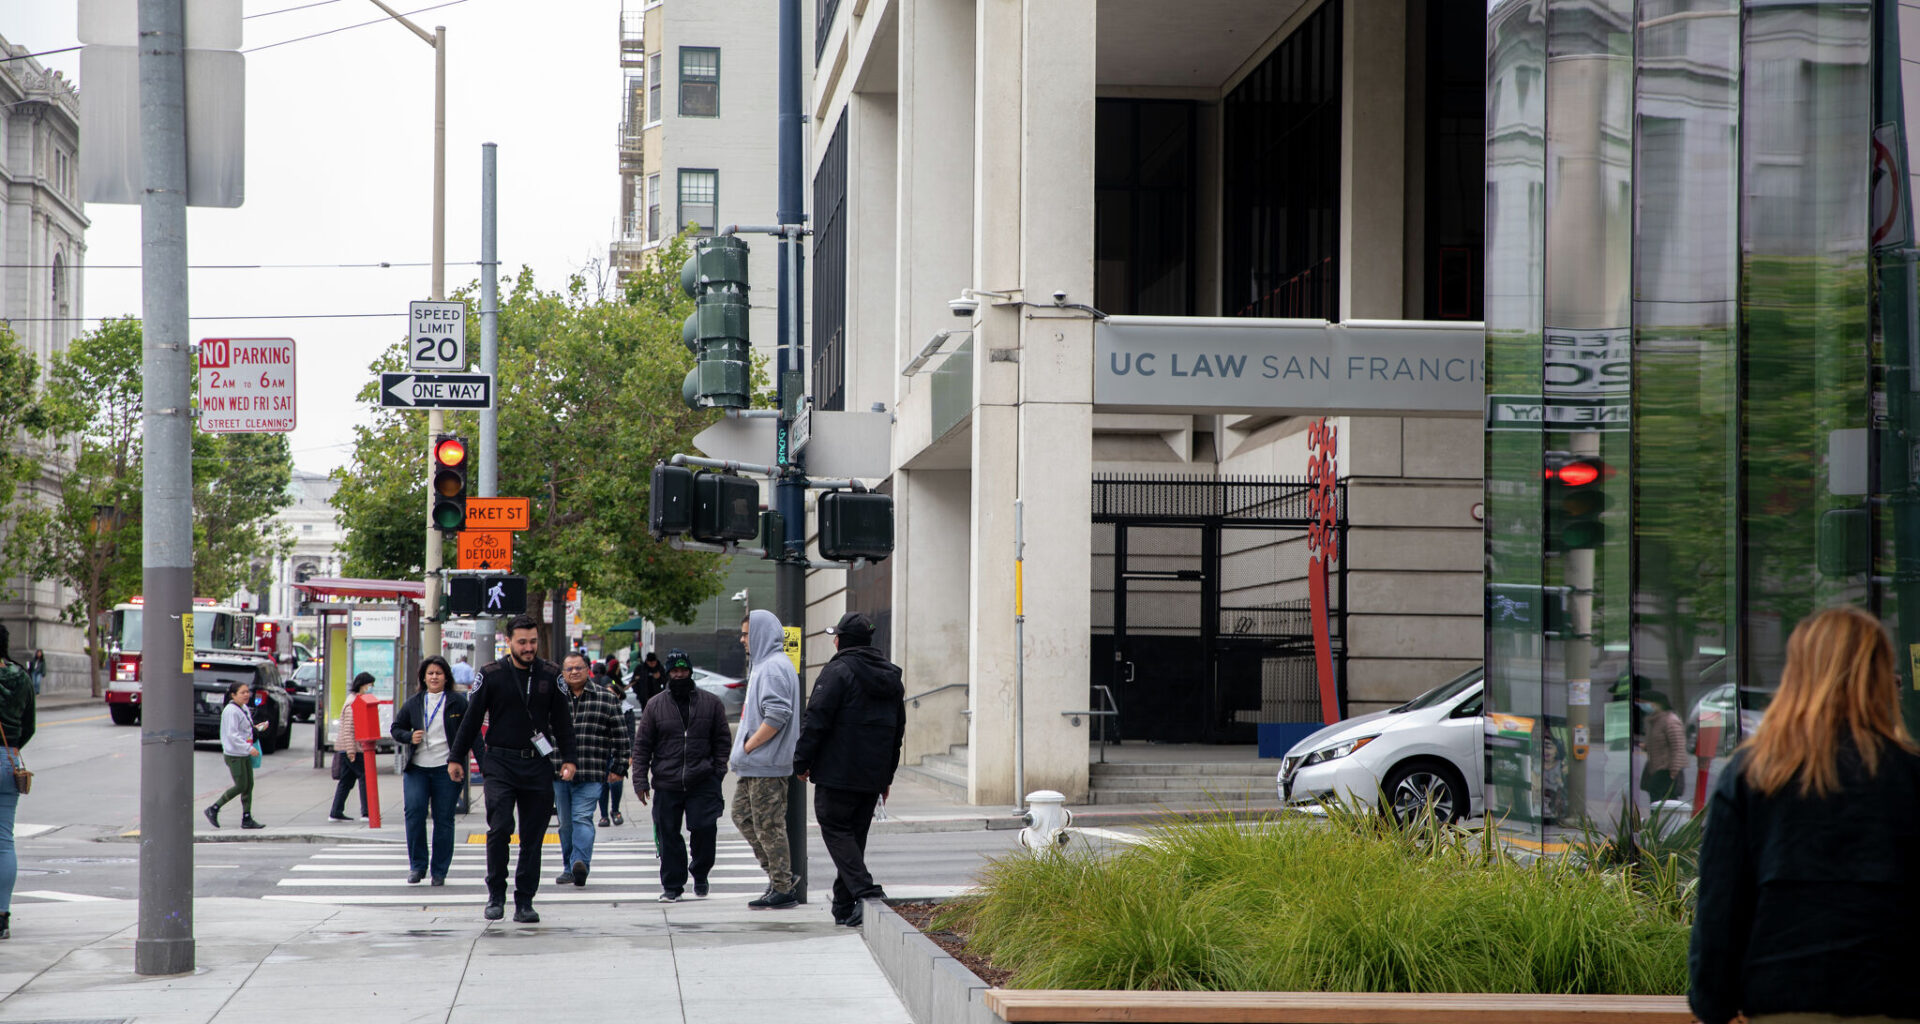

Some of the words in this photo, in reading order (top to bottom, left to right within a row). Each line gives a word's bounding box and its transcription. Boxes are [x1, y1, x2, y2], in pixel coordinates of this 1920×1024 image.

[415, 309, 460, 320] SPEED
[420, 323, 455, 334] LIMIT
[203, 342, 226, 365] NO
[233, 347, 290, 364] PARKING
[416, 337, 458, 362] 20
[1111, 352, 1156, 376] UC
[1171, 353, 1247, 378] LAW
[1262, 355, 1330, 380] SAN
[412, 384, 443, 398] ONE
[449, 384, 480, 399] WAY
[203, 396, 224, 411] MON
[229, 396, 250, 411] WED
[254, 396, 269, 410] FRI
[273, 396, 291, 410] SAT
[209, 419, 240, 428] STREET
[246, 419, 288, 428] CLEANING
[467, 508, 503, 519] RKET
[507, 508, 522, 519] ST
[466, 549, 506, 559] DETOUR
[463, 630, 476, 640] MEL
